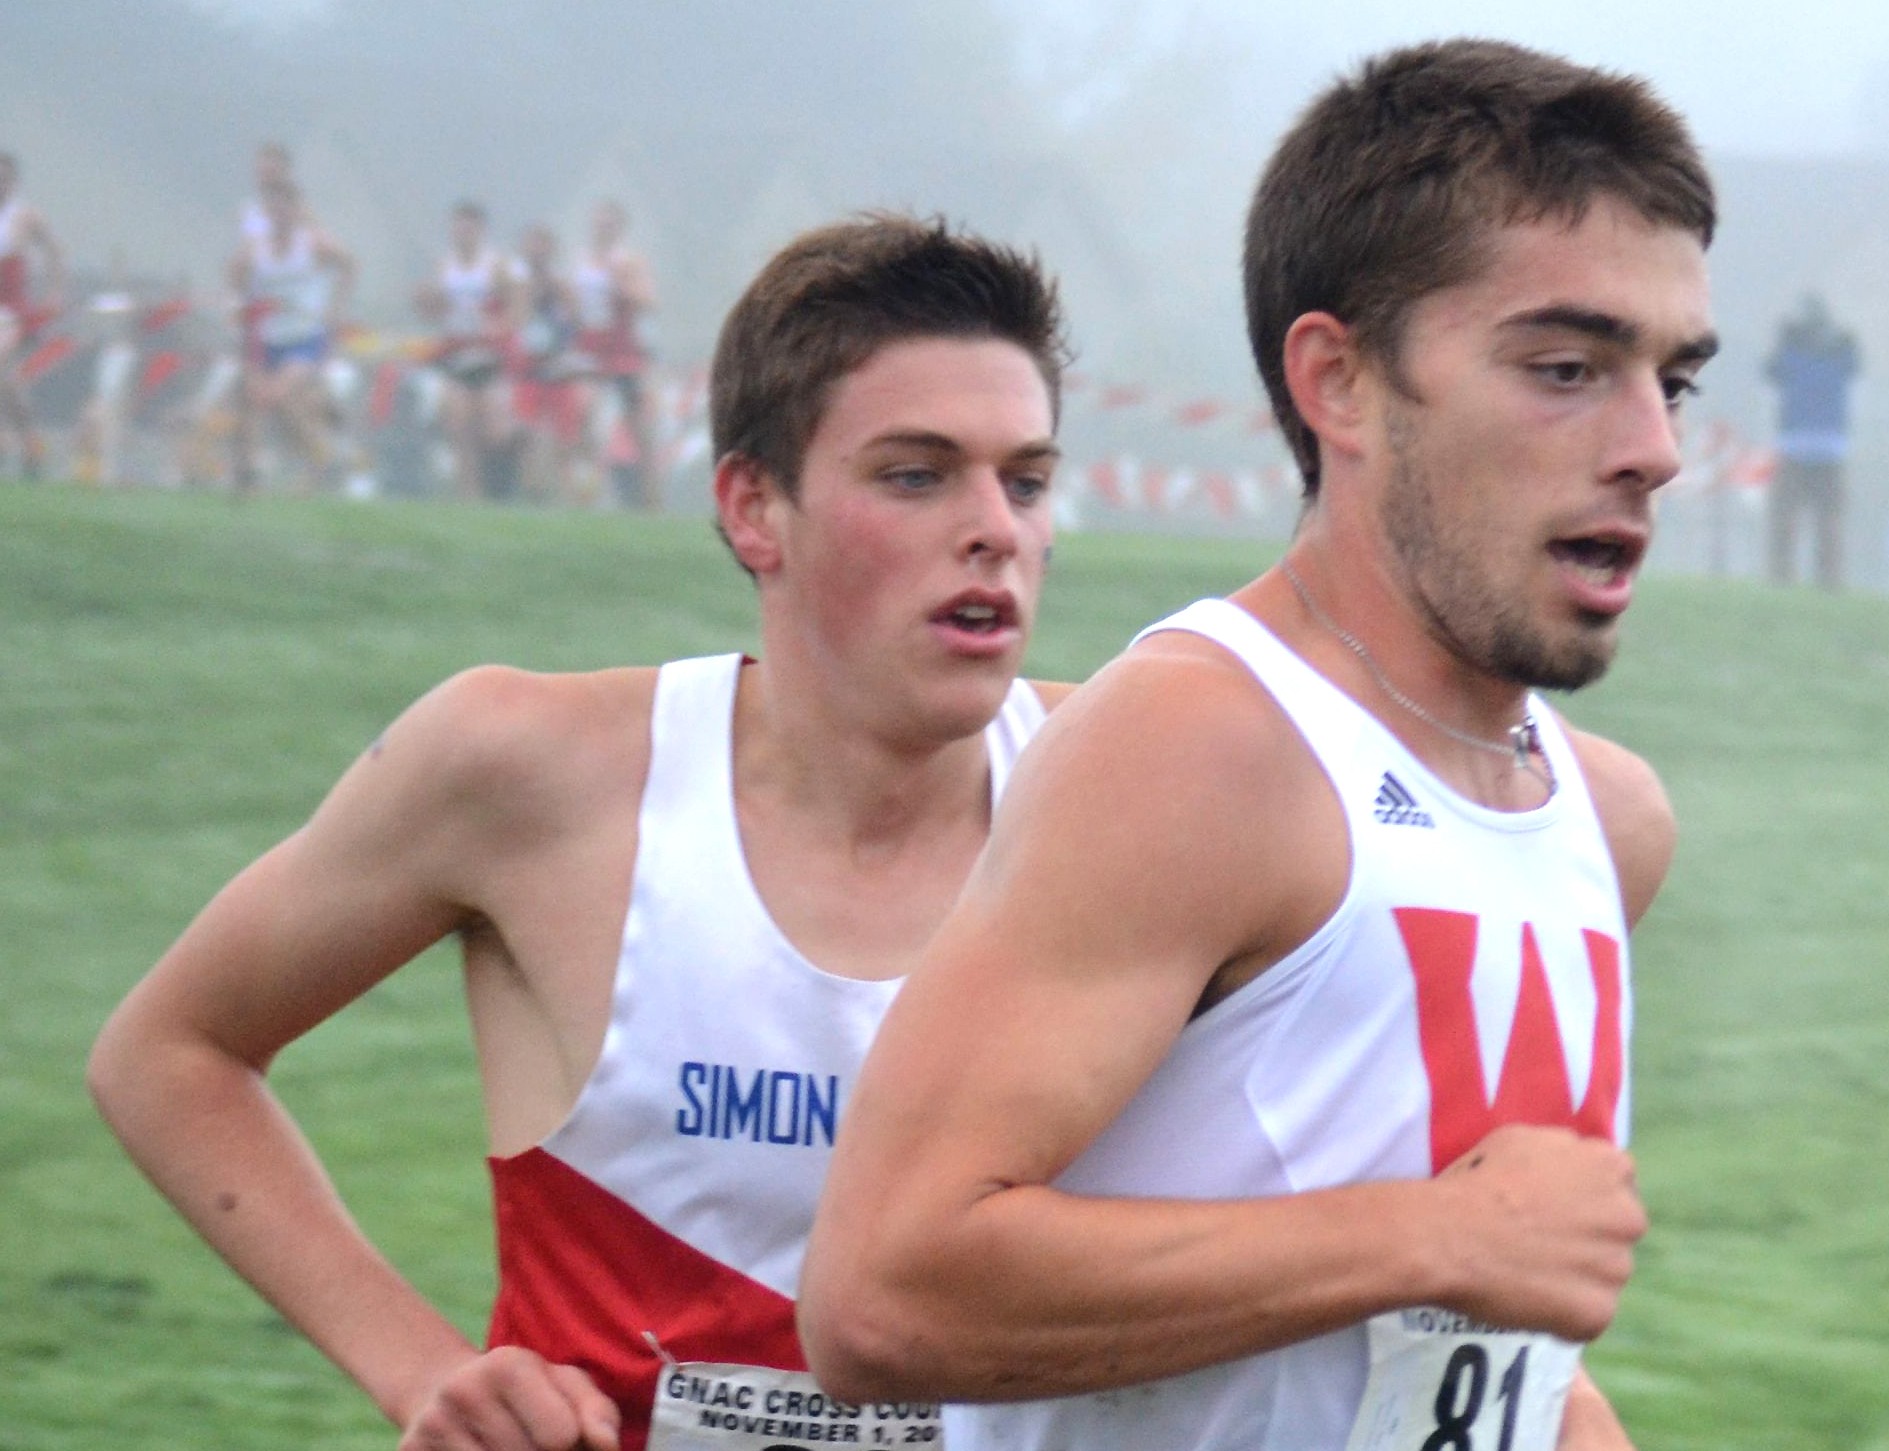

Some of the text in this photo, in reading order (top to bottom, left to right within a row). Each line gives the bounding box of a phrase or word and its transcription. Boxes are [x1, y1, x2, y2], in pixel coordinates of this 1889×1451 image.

[1390, 906, 1622, 1178] W
[676, 1061, 838, 1147] SIMON
[668, 1373, 754, 1410] GNAC
[766, 1390, 860, 1419] CROSS
[700, 1409, 942, 1445] NOVEMBER 1, 20
[1418, 1343, 1531, 1451] 81
